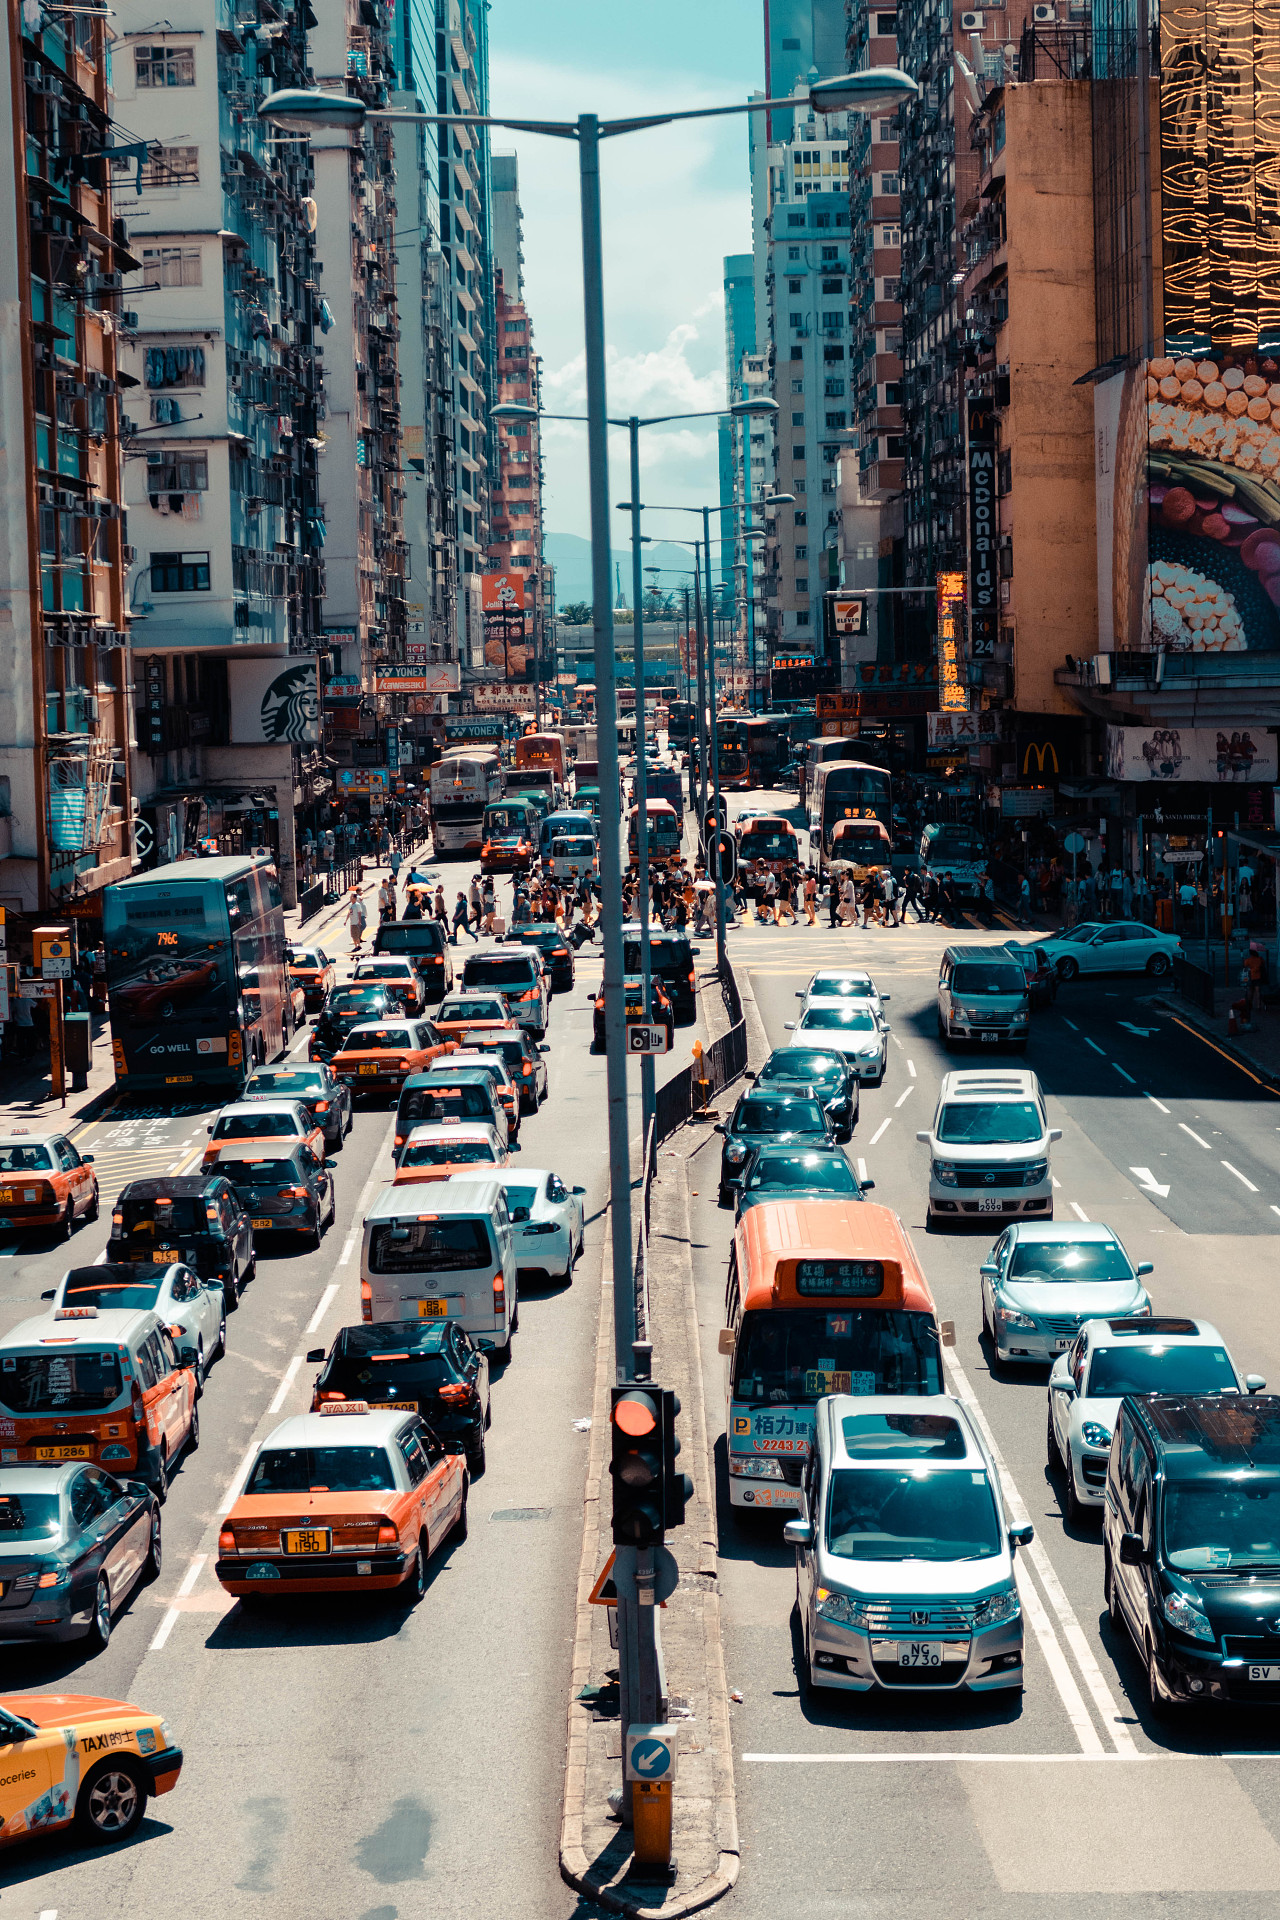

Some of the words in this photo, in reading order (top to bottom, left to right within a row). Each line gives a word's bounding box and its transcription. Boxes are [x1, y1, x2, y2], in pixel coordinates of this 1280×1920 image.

[971, 451, 994, 605] McDonald's
[975, 640, 994, 655] 24
[395, 667, 425, 677] YONEX
[468, 726, 498, 736] YONEX
[865, 808, 877, 818] 2A
[157, 932, 178, 945] 796C
[150, 1046, 165, 1054] GO
[167, 1044, 191, 1053] WELL
[838, 1264, 863, 1277] 旺角
[62, 1309, 89, 1317] TAXI
[423, 1308, 443, 1317] 1981
[830, 1321, 846, 1333] 71
[324, 1404, 364, 1413] TAXI
[388, 1403, 416, 1412] 7608
[755, 1415, 812, 1435] 栢力建
[762, 1440, 794, 1451] 2243
[40, 1448, 55, 1458] UZ
[57, 1447, 85, 1457] 1286
[299, 1532, 315, 1541] SH
[294, 1542, 320, 1552] 1190
[911, 1644, 930, 1655] NG
[902, 1655, 939, 1666] 8730
[1252, 1668, 1270, 1679] SV
[81, 1734, 109, 1752] TAXI
[109, 1729, 134, 1746] 的士
[0, 1769, 36, 1786] oceries
